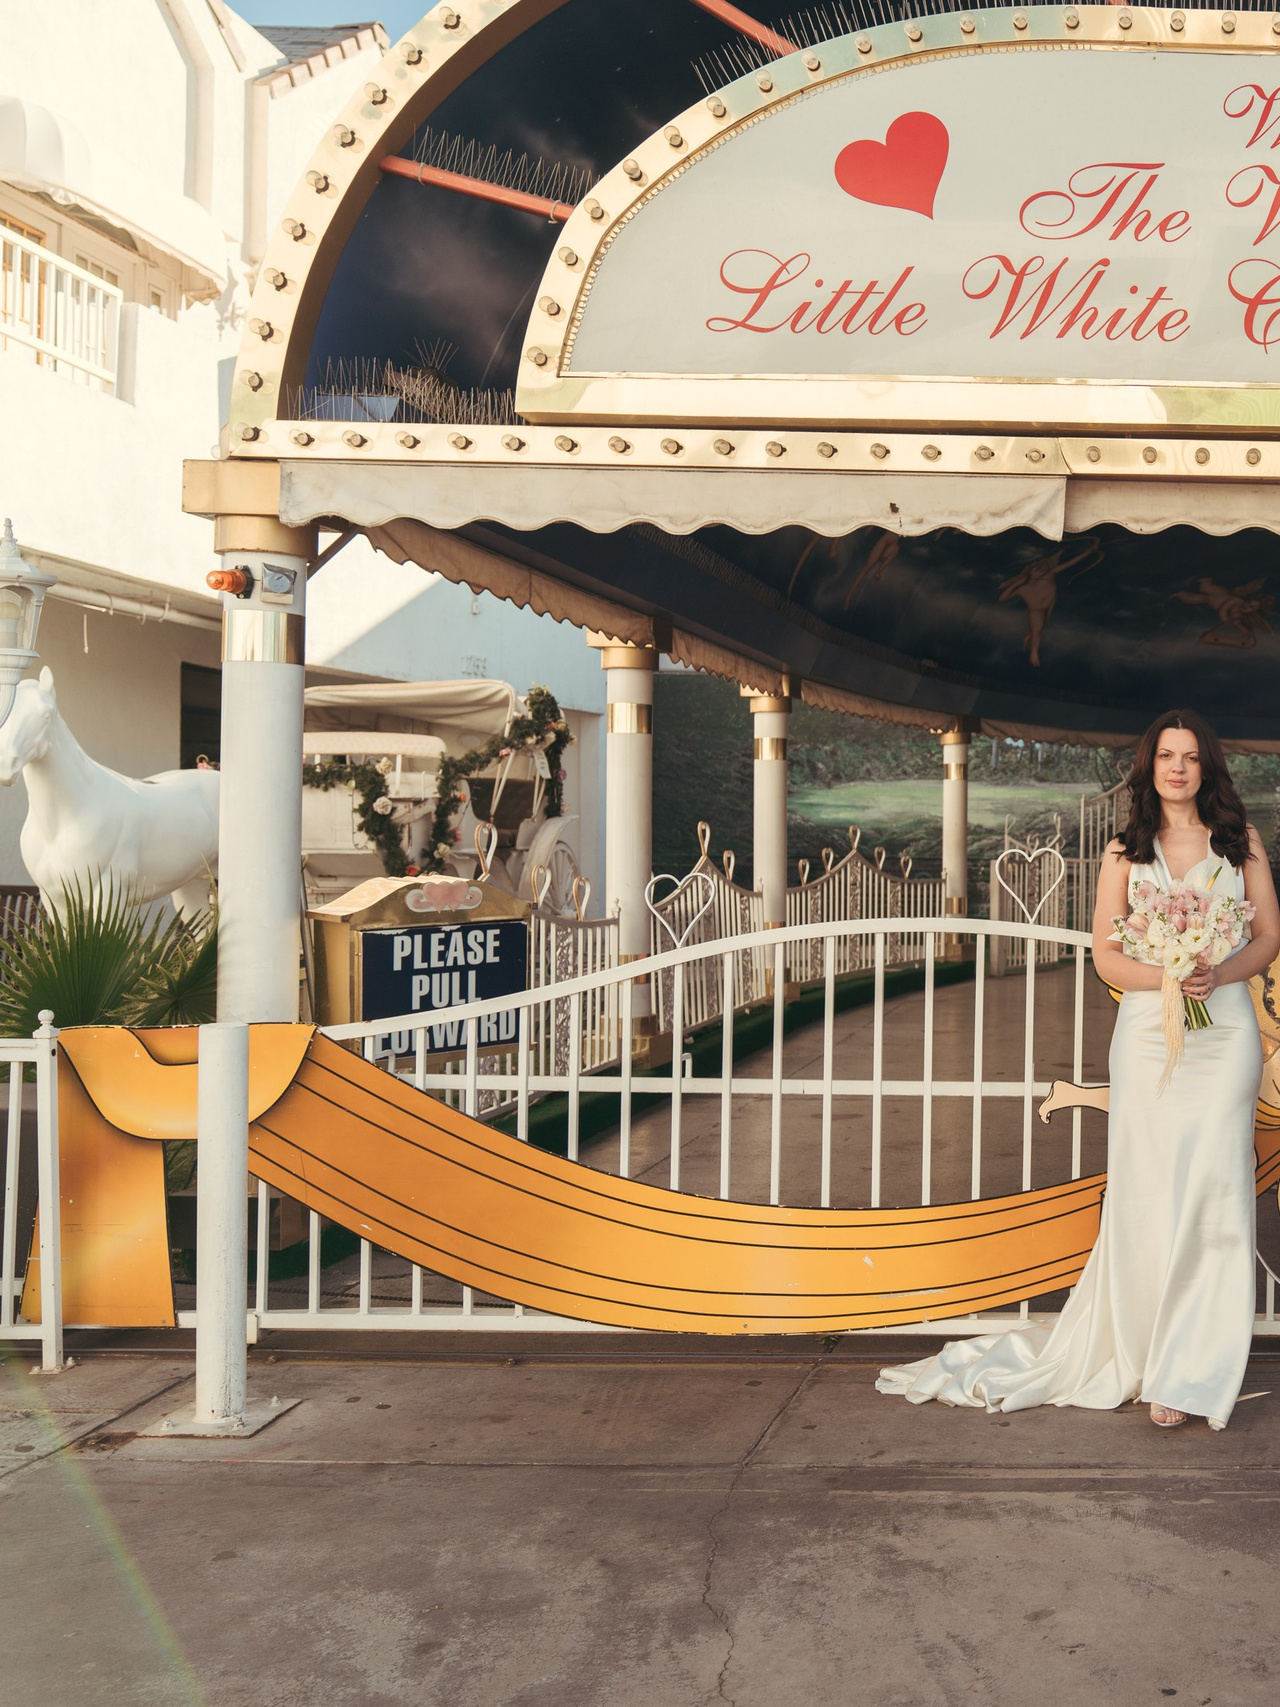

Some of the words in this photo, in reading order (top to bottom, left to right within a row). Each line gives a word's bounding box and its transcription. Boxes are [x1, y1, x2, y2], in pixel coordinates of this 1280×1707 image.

[1019, 162, 1192, 243] The
[706, 249, 928, 336] Little
[961, 254, 1191, 343] White
[393, 929, 500, 971] PLEASE
[411, 970, 482, 1010] PULL
